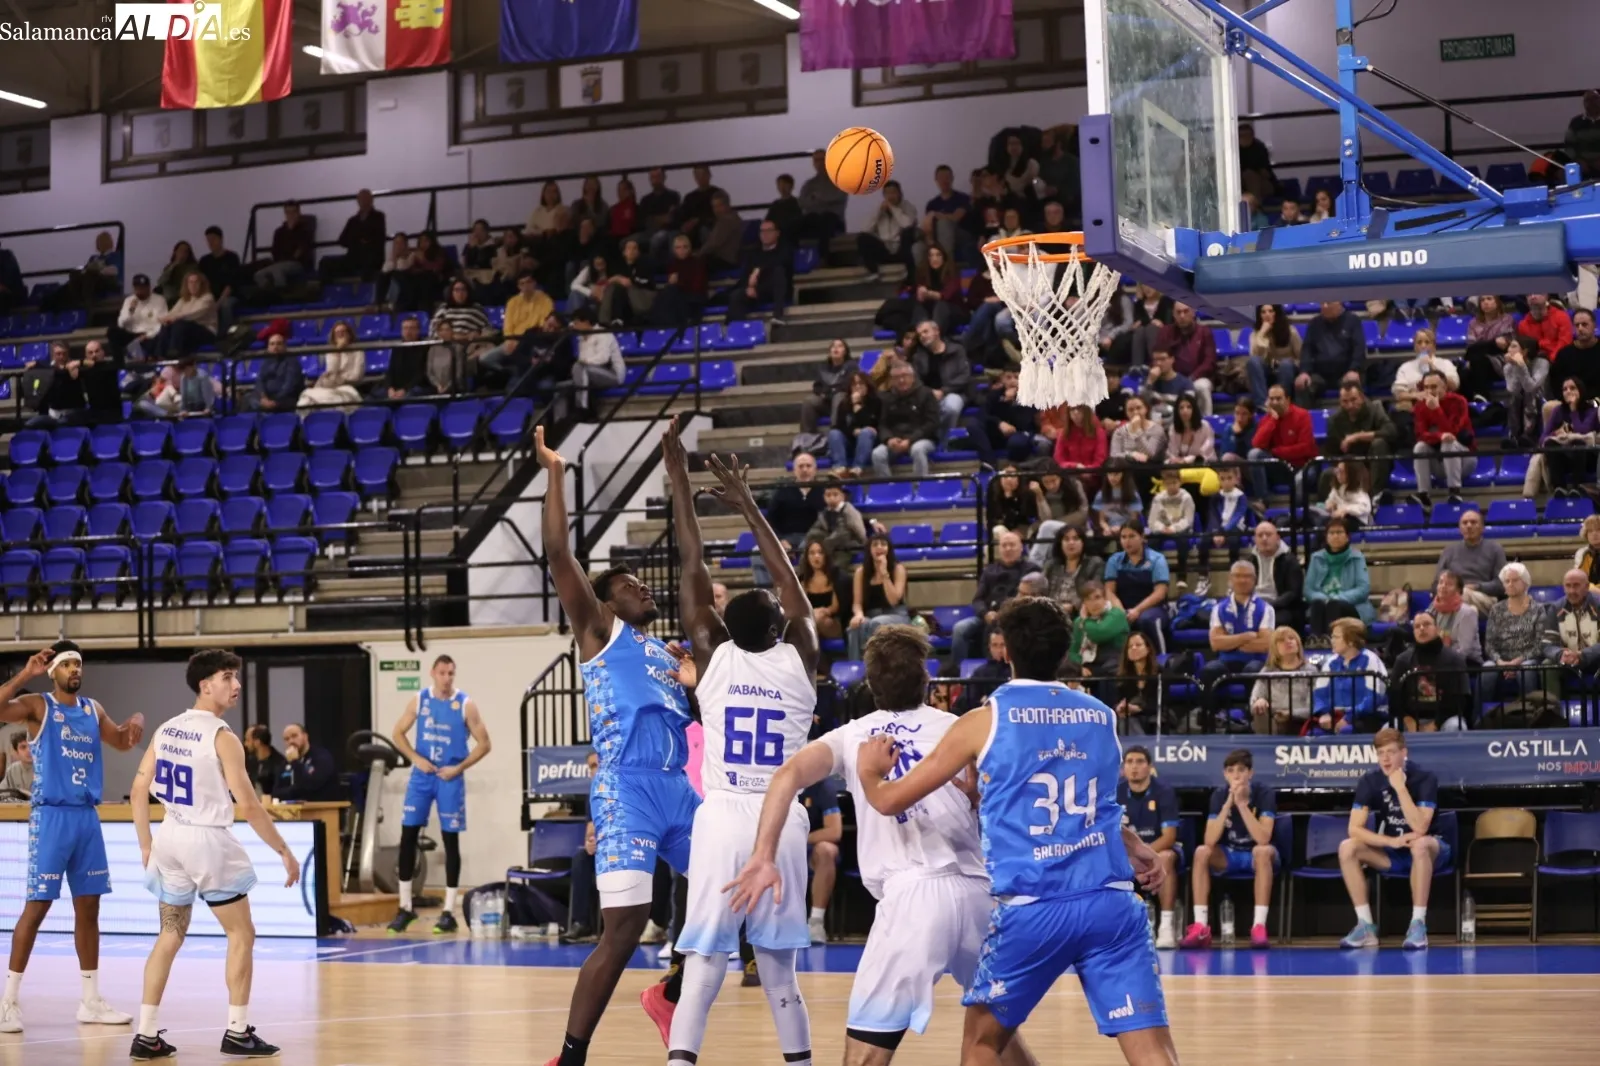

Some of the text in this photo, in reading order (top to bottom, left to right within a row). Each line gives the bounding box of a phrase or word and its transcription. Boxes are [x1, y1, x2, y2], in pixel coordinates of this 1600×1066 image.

[1348, 248, 1428, 270] MONDO
[1008, 706, 1108, 726] CHOITHRAMANI
[161, 727, 203, 743] HERNÁN
[723, 706, 787, 767] 66
[1154, 740, 1207, 763] LEÓN
[1275, 744, 1380, 766] SALAMAN
[1487, 739, 1588, 758] CASTILLA
[1537, 760, 1600, 775] NOS IMPU
[154, 758, 194, 807] 99
[1027, 772, 1098, 836] 34
